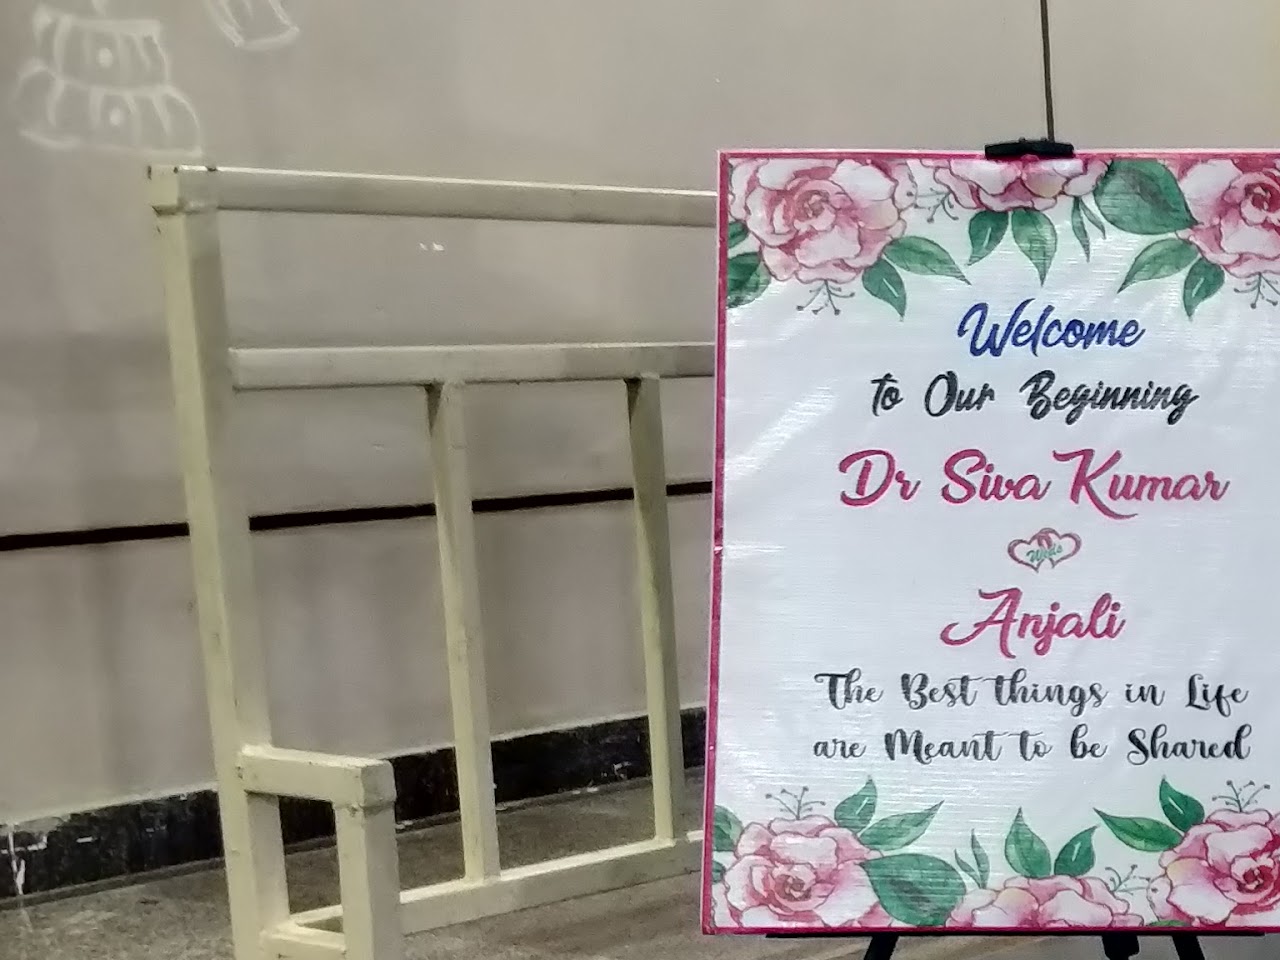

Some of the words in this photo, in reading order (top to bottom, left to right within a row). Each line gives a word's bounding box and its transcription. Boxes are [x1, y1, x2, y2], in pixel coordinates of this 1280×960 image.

[957, 298, 1146, 358] Welcome
[870, 372, 904, 417] to
[923, 370, 996, 418] Our
[1018, 369, 1201, 426] Beginning
[837, 449, 922, 507] Dr
[940, 448, 1052, 505] Siva
[1052, 448, 1231, 520] Kumar
[940, 587, 1127, 659] Anjali
[813, 669, 884, 707] The
[900, 671, 983, 708] Best
[989, 669, 1109, 717] things
[1124, 682, 1166, 706] in
[1185, 672, 1250, 716] Life
[812, 737, 867, 760] are
[883, 730, 1006, 764] Meant
[1016, 730, 1053, 761] to
[1069, 728, 1108, 761] be
[1126, 724, 1252, 763] Shared
